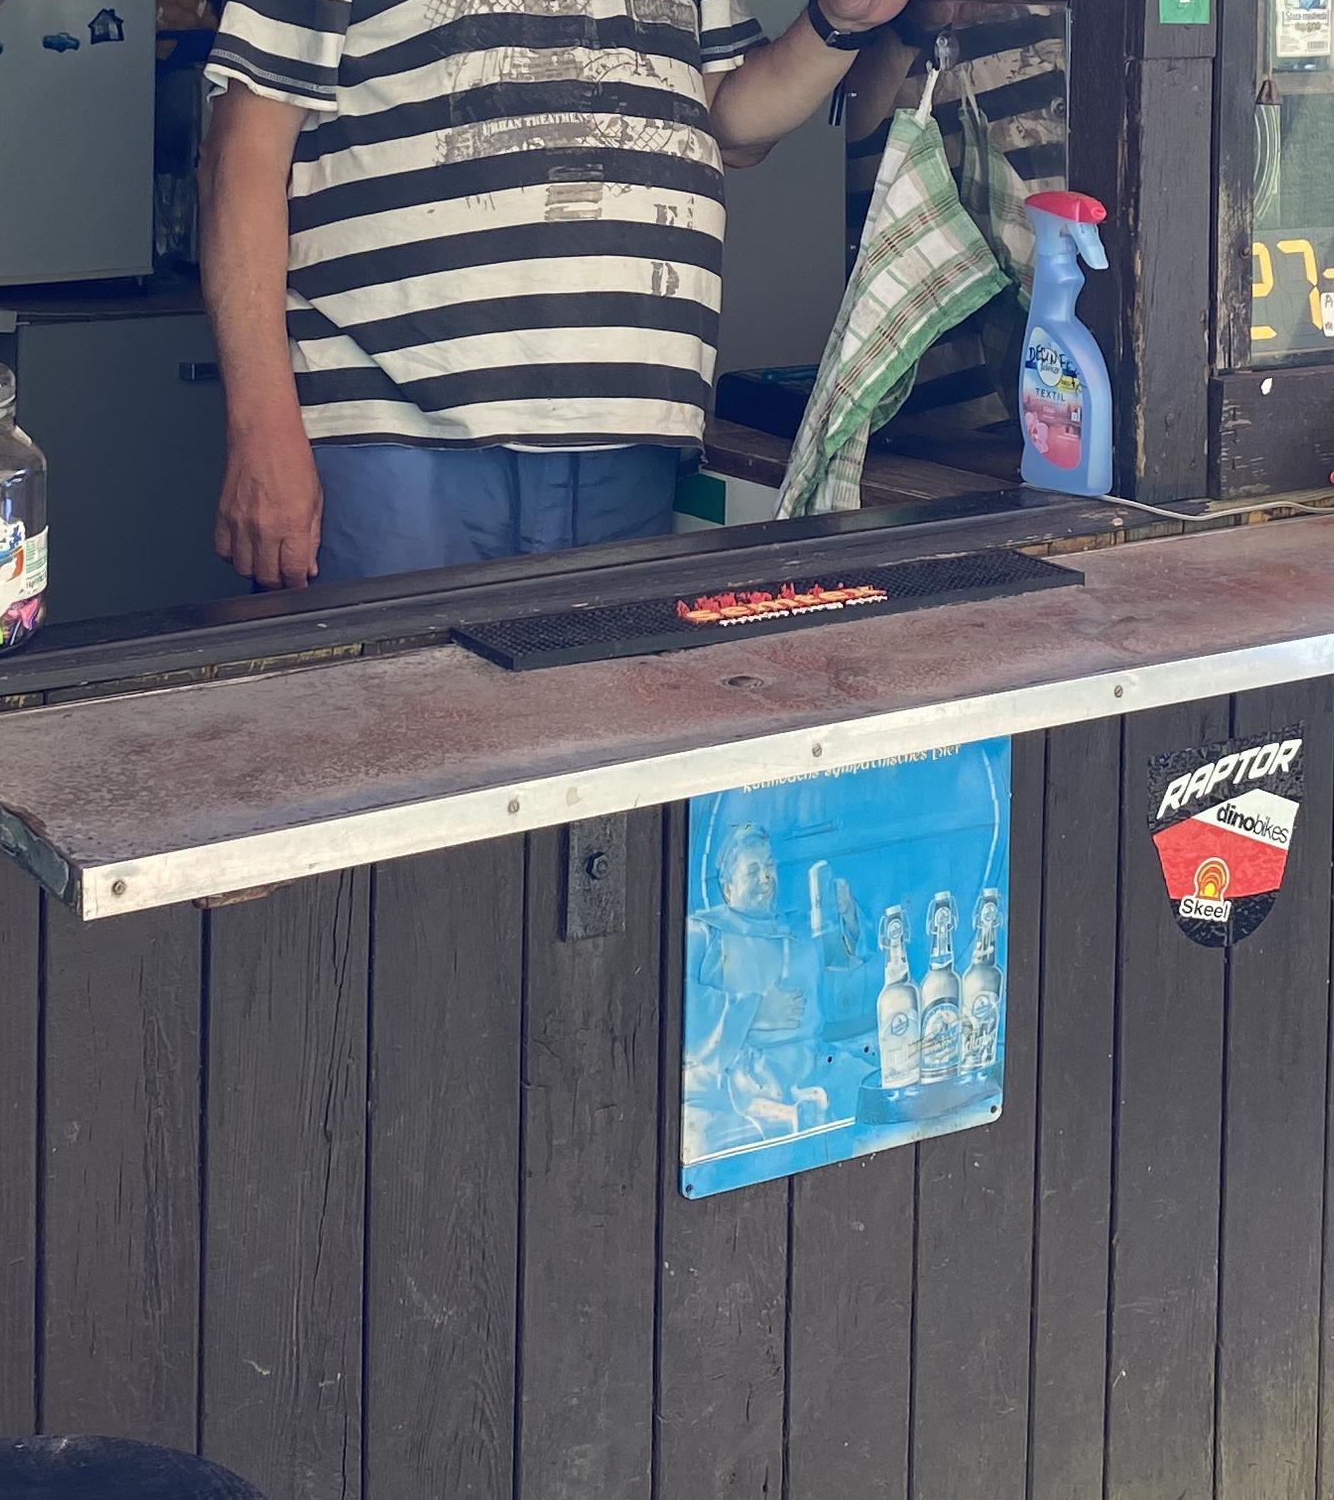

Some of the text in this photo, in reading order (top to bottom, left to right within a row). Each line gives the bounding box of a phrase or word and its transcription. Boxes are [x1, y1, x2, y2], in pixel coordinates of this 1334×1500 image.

[1035, 388, 1066, 403] TEXTIL
[1157, 739, 1303, 820] RAPTOR
[1217, 804, 1288, 844] dinobikes
[1182, 899, 1229, 919] Skeel
